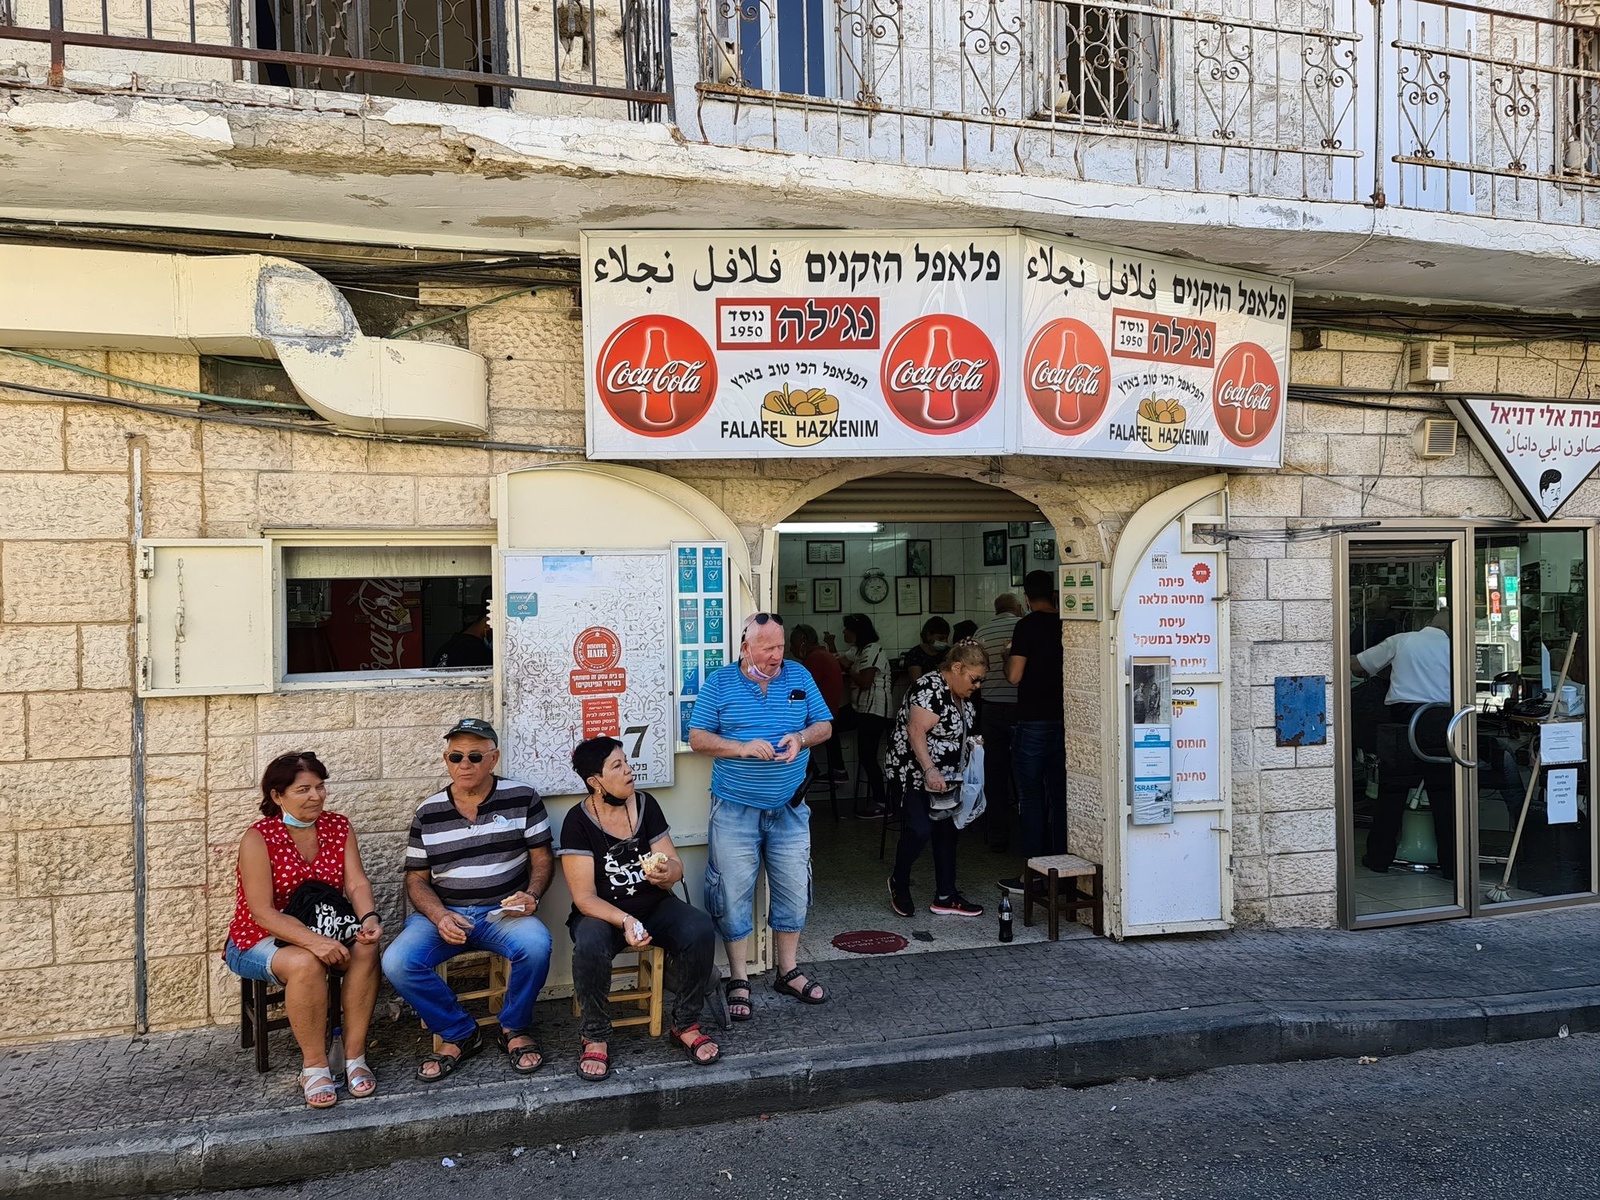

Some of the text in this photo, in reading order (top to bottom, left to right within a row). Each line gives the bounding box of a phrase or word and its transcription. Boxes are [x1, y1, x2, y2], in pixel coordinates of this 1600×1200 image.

[594, 245, 782, 294] فلافل نجلاء
[805, 243, 1000, 292] פלאפל הזקנים
[1027, 246, 1156, 300] فلافل نجلاء
[1172, 274, 1286, 320] פלאפל הזקנים
[728, 310, 765, 322] נוסד
[1120, 320, 1144, 333] נוסד
[730, 326, 763, 337] 1950
[1120, 335, 1143, 347] 1950
[607, 359, 707, 394] Coca-Cola
[730, 361, 868, 390] הפלאפל הכי טוב בארץ
[891, 359, 990, 394] Coca-Cola
[1031, 359, 1103, 396] Coca-Cola
[1117, 373, 1205, 402] הפלאפל הכי טוב בארץ
[1218, 379, 1275, 411] Coca-Cola
[1490, 402, 1535, 425] דניאל
[1539, 404, 1566, 427] אלי
[721, 420, 878, 439] FALAFEL HAZKENIM
[1109, 424, 1209, 446] FALAFEL HAZKENIM
[1506, 433, 1538, 457] دانيال
[1158, 578, 1185, 587] פיתה
[1138, 593, 1204, 604] מחיטה מלאה
[359, 579, 404, 669] oca-Col
[1159, 617, 1185, 628] עיסת
[1133, 633, 1211, 647] פלאפל במשקל
[587, 649, 608, 658] HAIFA
[624, 724, 650, 758] 7
[1177, 739, 1206, 749] חומוס
[630, 762, 648, 771] פלא
[1176, 771, 1206, 782] טחינה
